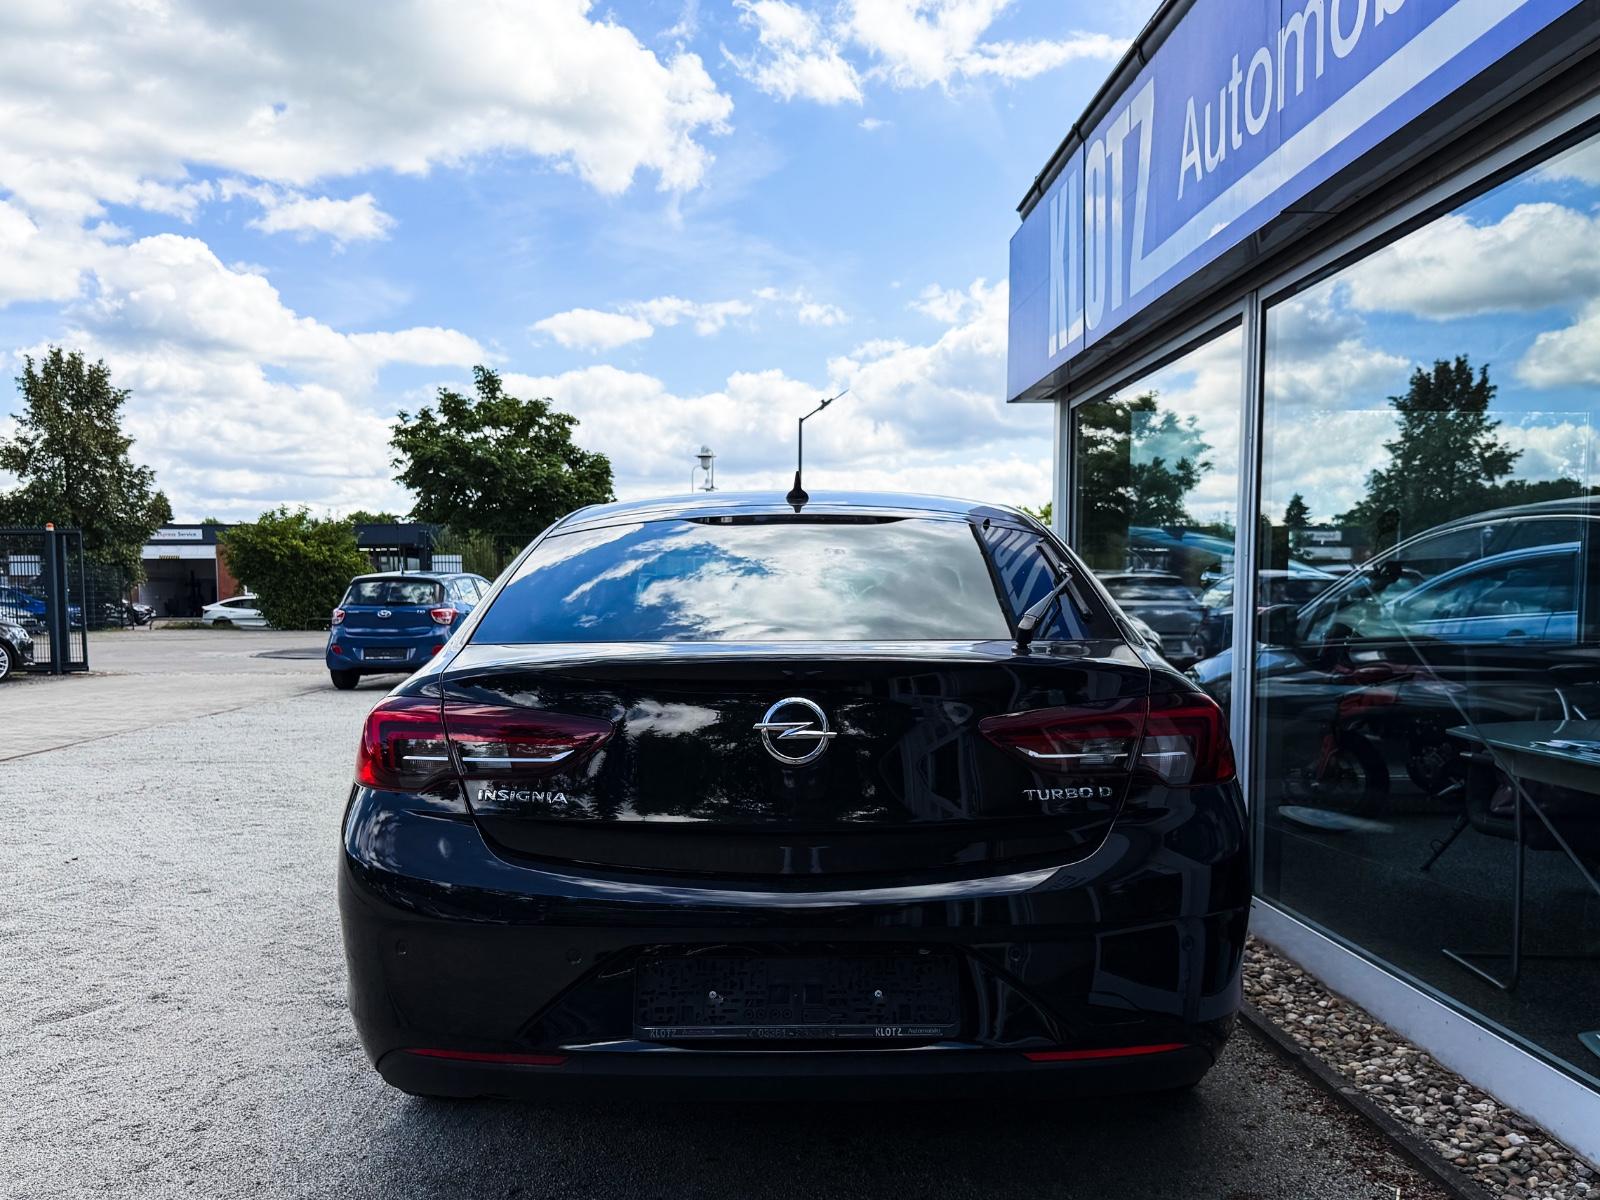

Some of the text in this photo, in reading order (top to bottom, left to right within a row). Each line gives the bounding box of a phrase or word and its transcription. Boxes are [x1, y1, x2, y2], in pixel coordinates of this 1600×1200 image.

[1048, 0, 1405, 359] KLOTZ Automo
[477, 789, 568, 804] INSIGNIA
[1022, 786, 1113, 801] TURBO D
[875, 1027, 903, 1037] KLOTZ
